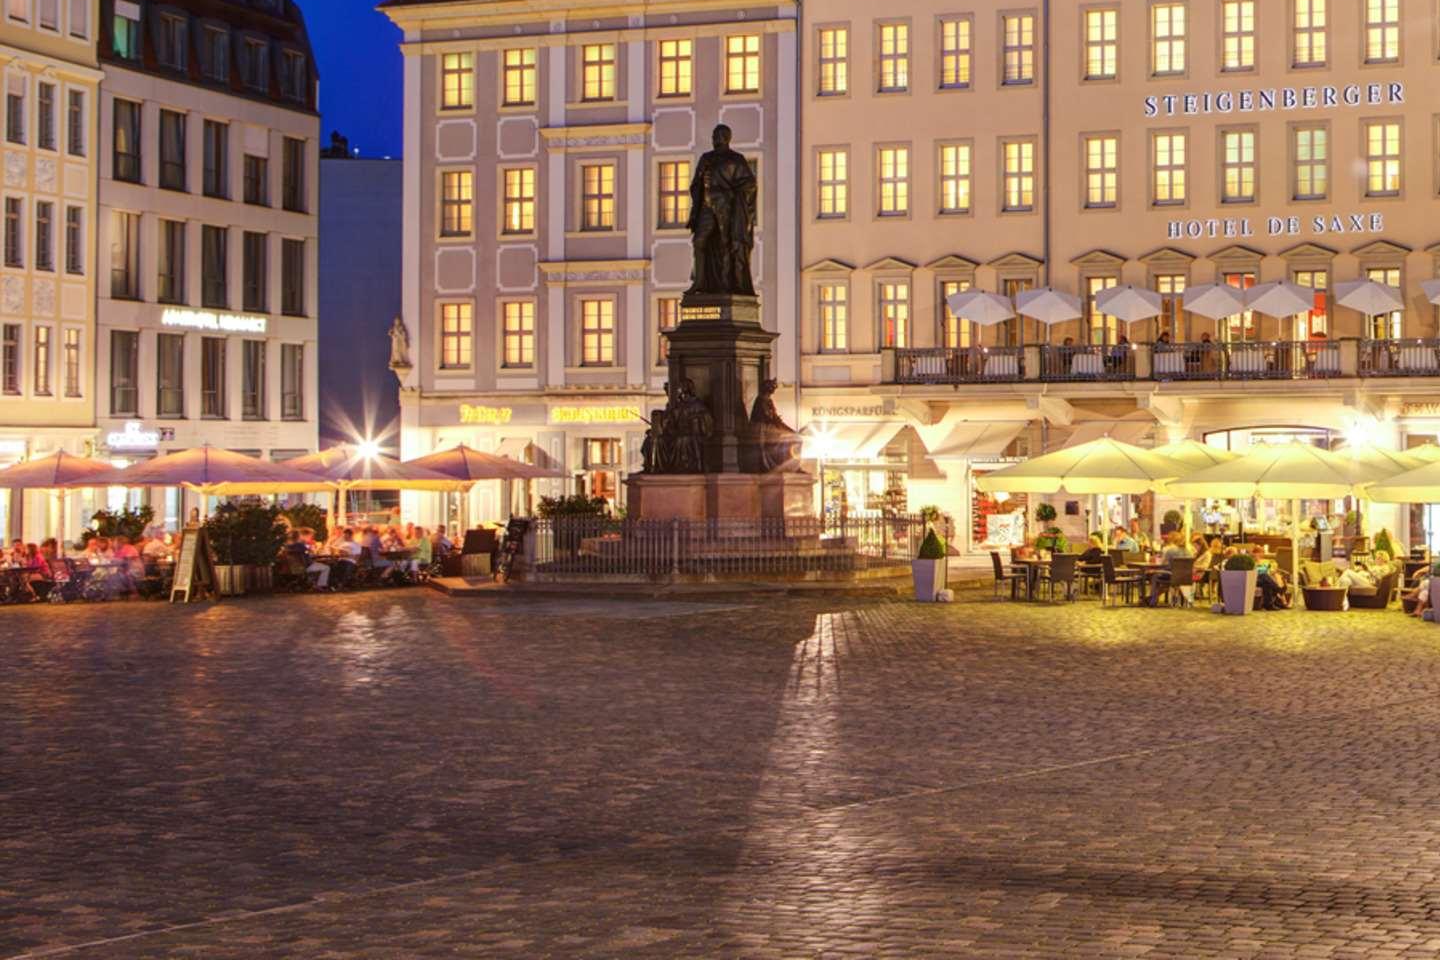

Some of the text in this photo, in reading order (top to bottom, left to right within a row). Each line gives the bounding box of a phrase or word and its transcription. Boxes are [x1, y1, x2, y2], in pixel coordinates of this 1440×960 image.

[1144, 81, 1405, 118] STEIGENBERGER
[1167, 212, 1385, 240] HOTEL DE SAXE
